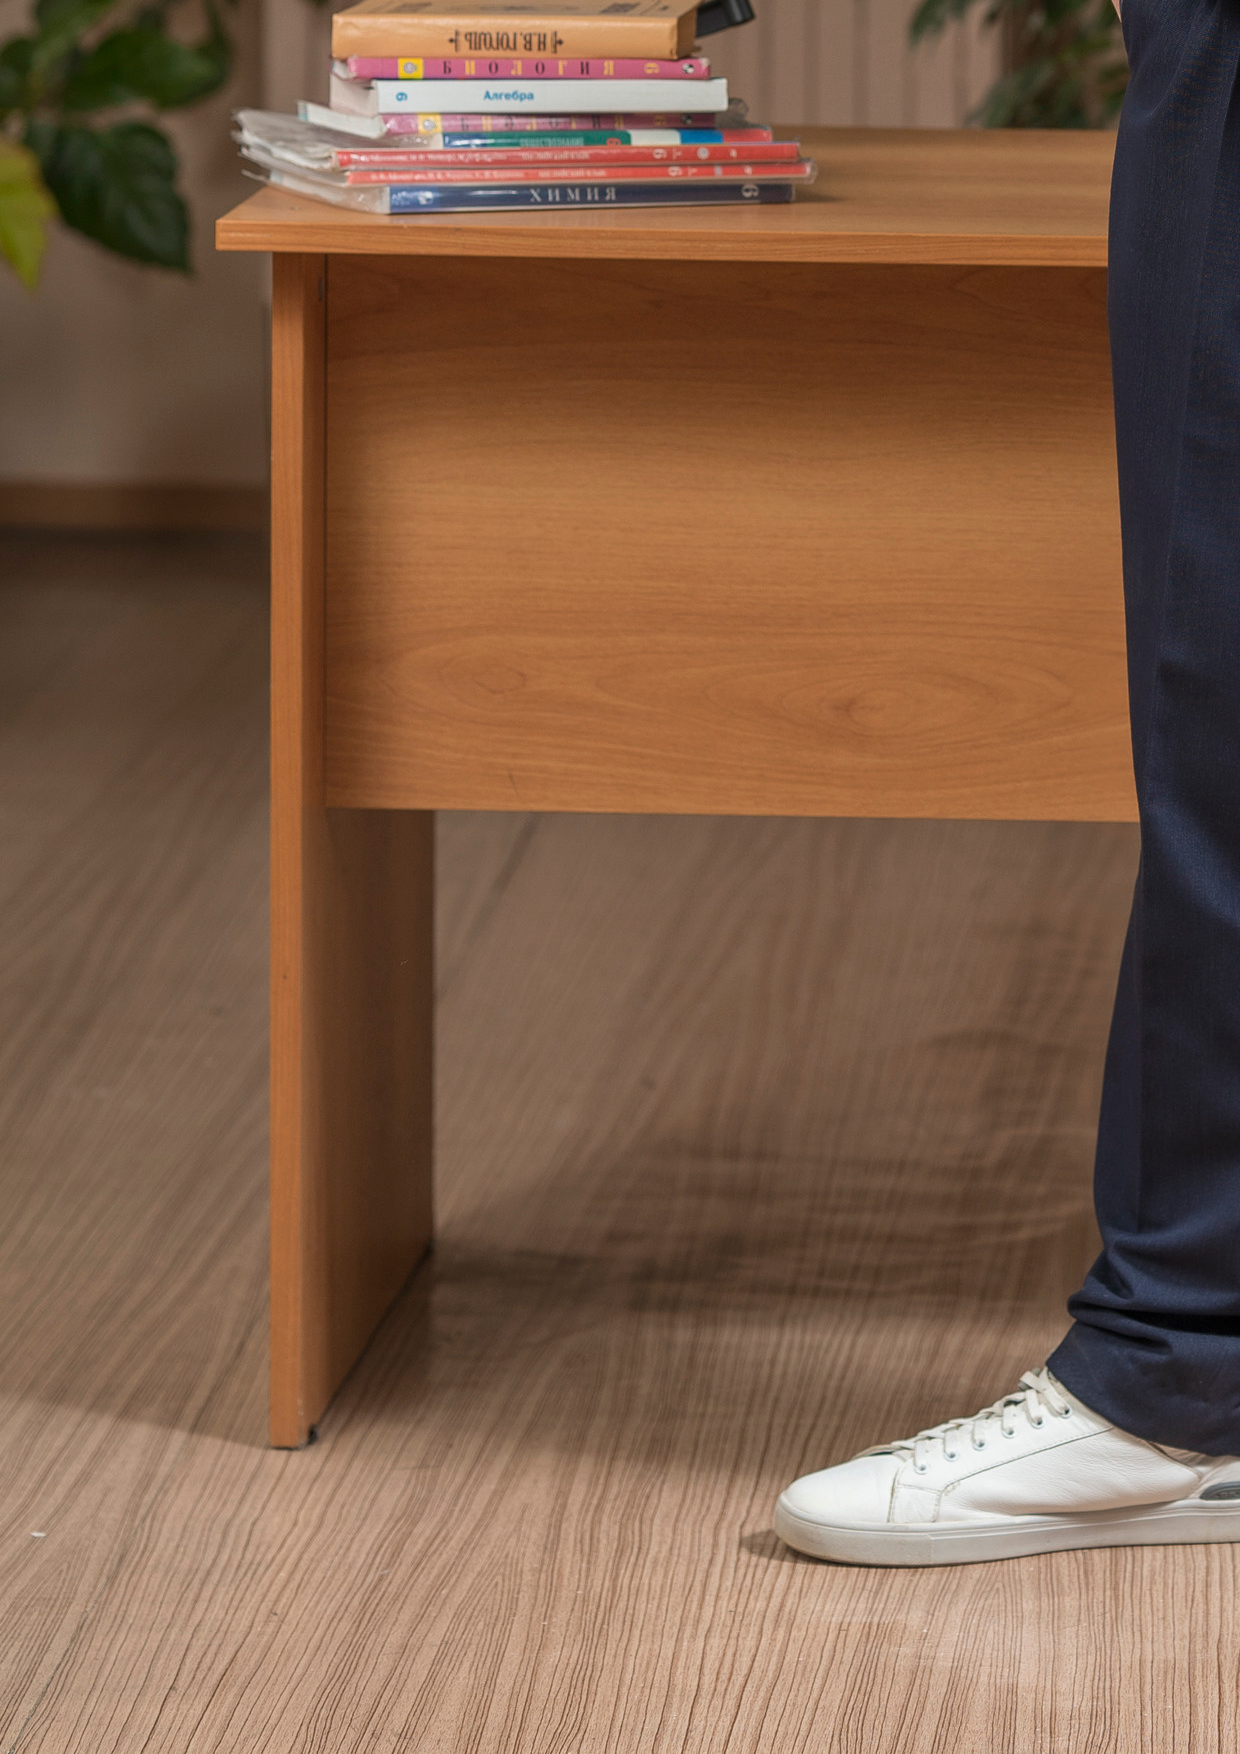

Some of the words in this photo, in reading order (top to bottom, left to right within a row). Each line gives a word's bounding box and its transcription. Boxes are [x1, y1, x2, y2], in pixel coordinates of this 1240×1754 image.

[443, 60, 614, 76] БИОЛОГИЯ
[483, 89, 535, 103] Алгебра
[529, 187, 616, 203] ХИМИЯ
